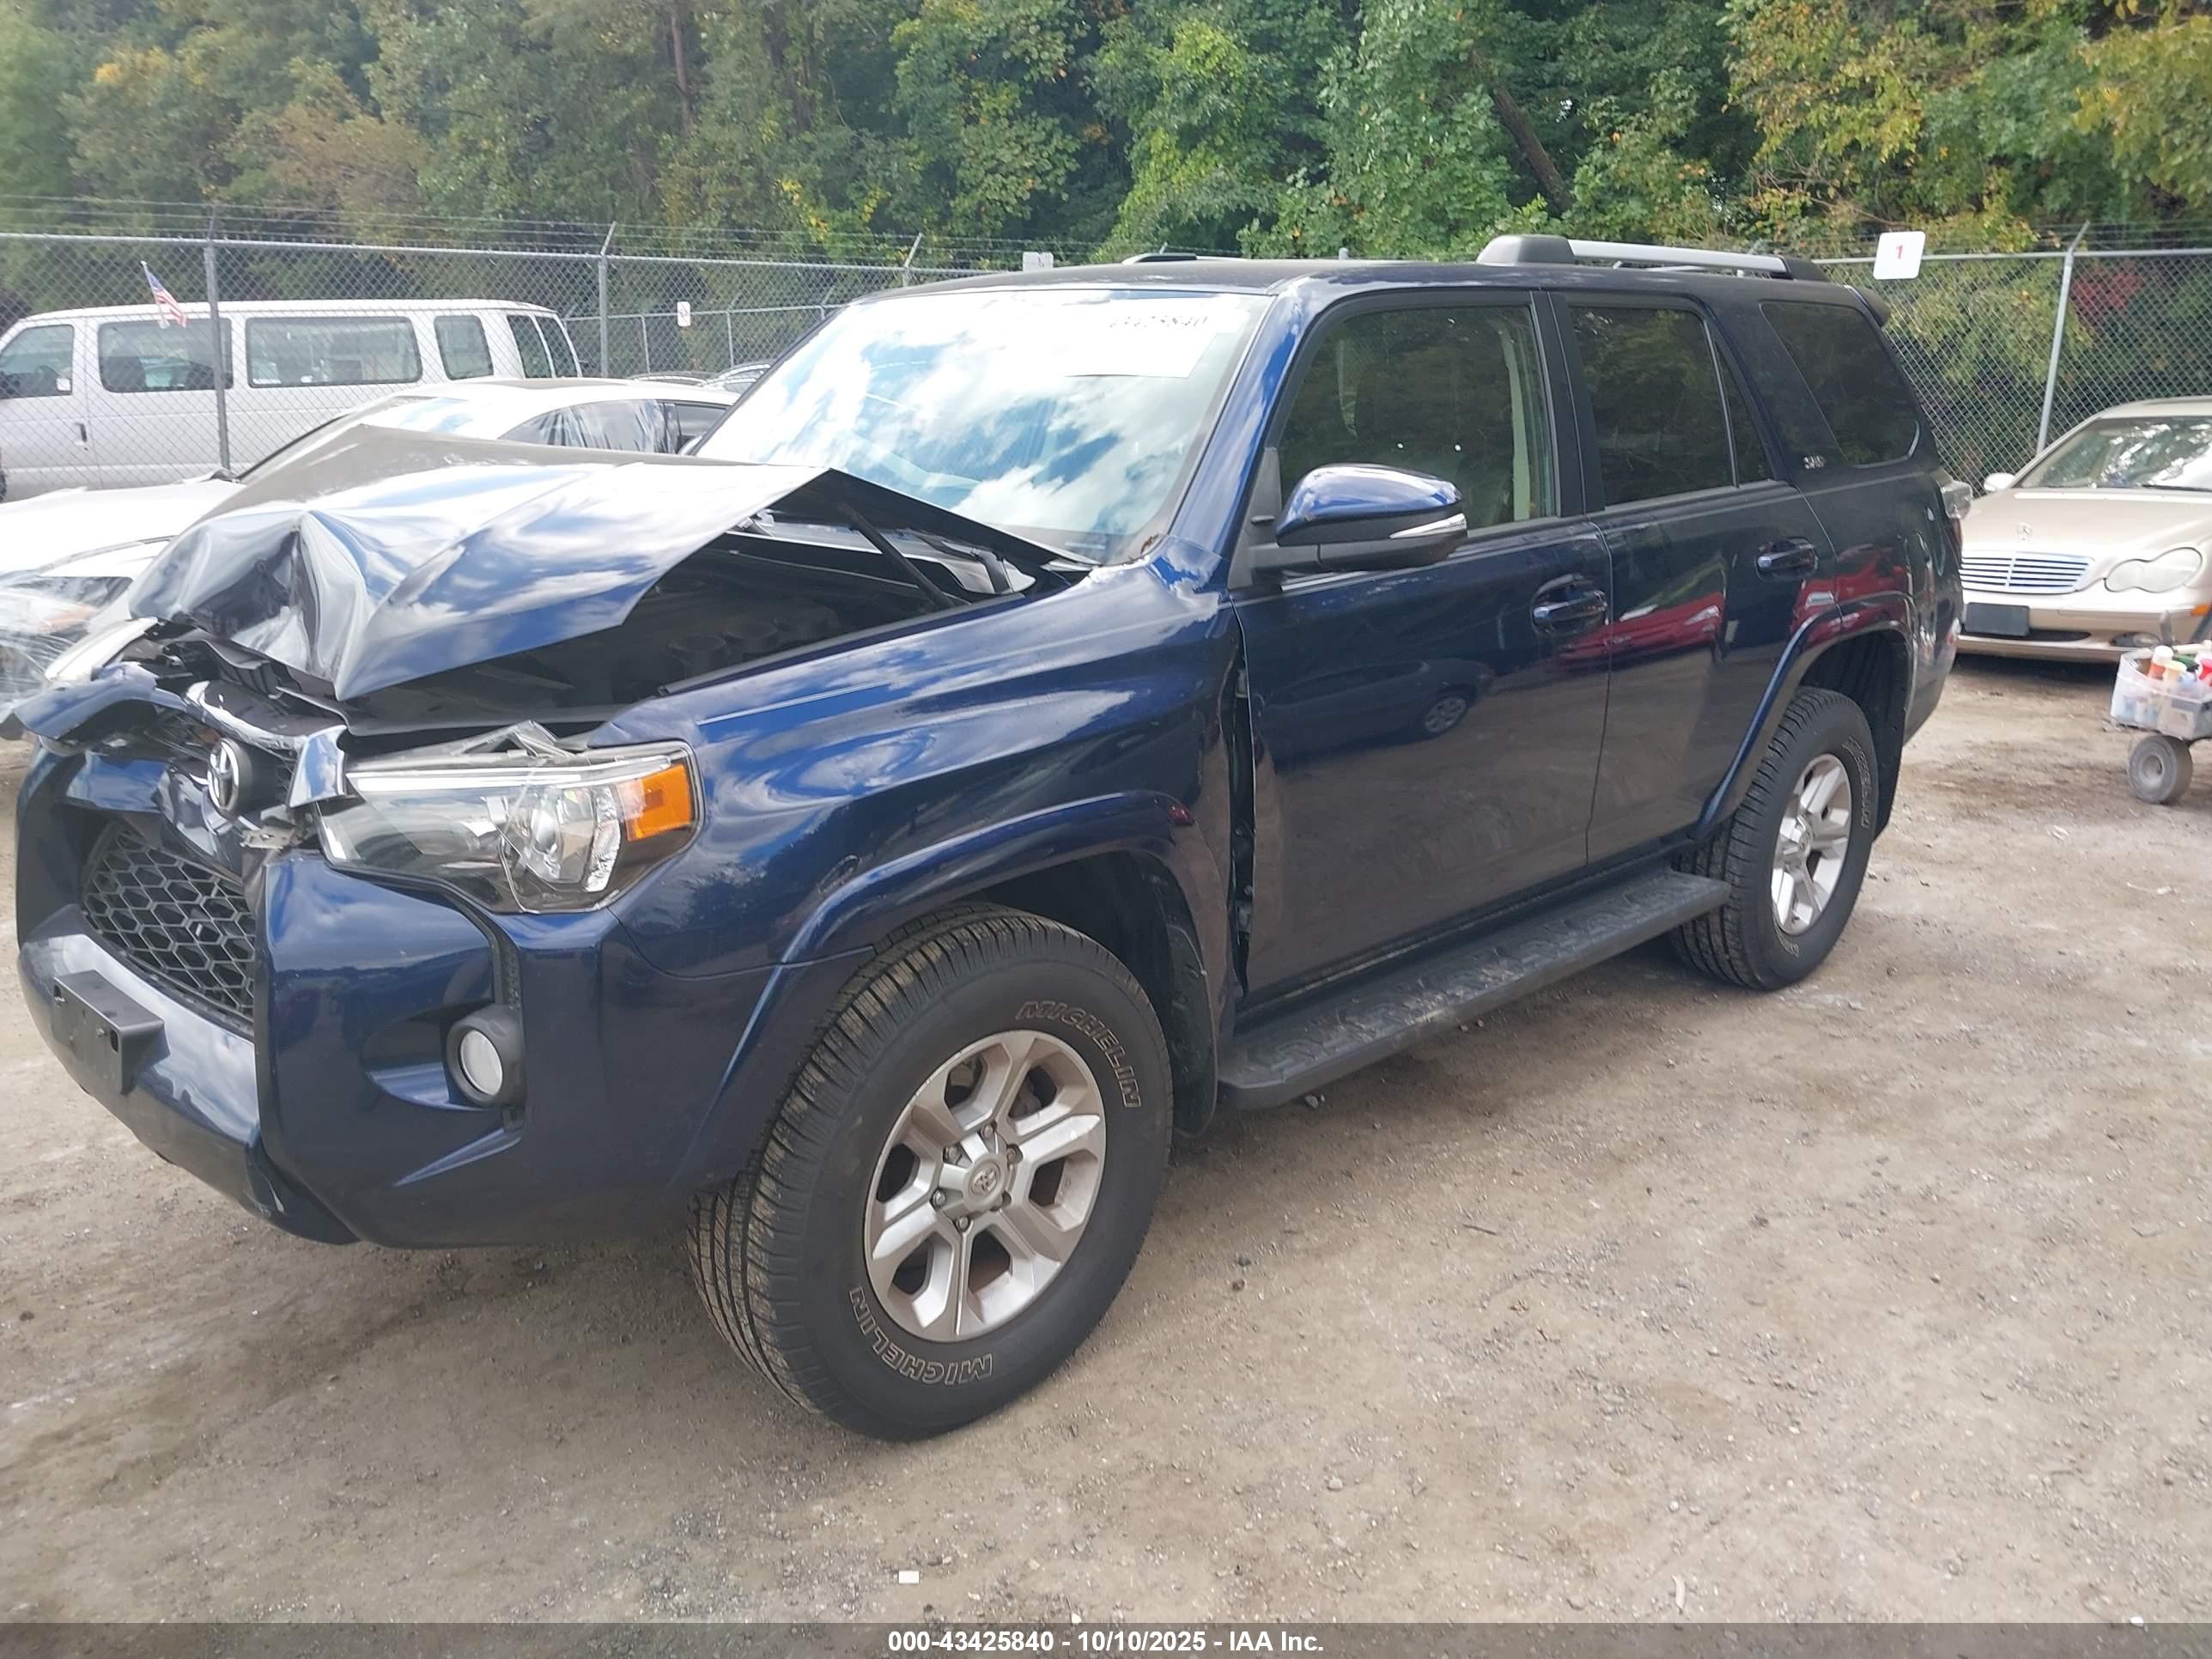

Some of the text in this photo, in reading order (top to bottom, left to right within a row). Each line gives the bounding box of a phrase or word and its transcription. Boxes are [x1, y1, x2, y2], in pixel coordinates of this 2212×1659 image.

[1896, 243, 1904, 260] 1
[1014, 1000, 1143, 1109] MICHELIN
[848, 1285, 994, 1386] MICHELIN
